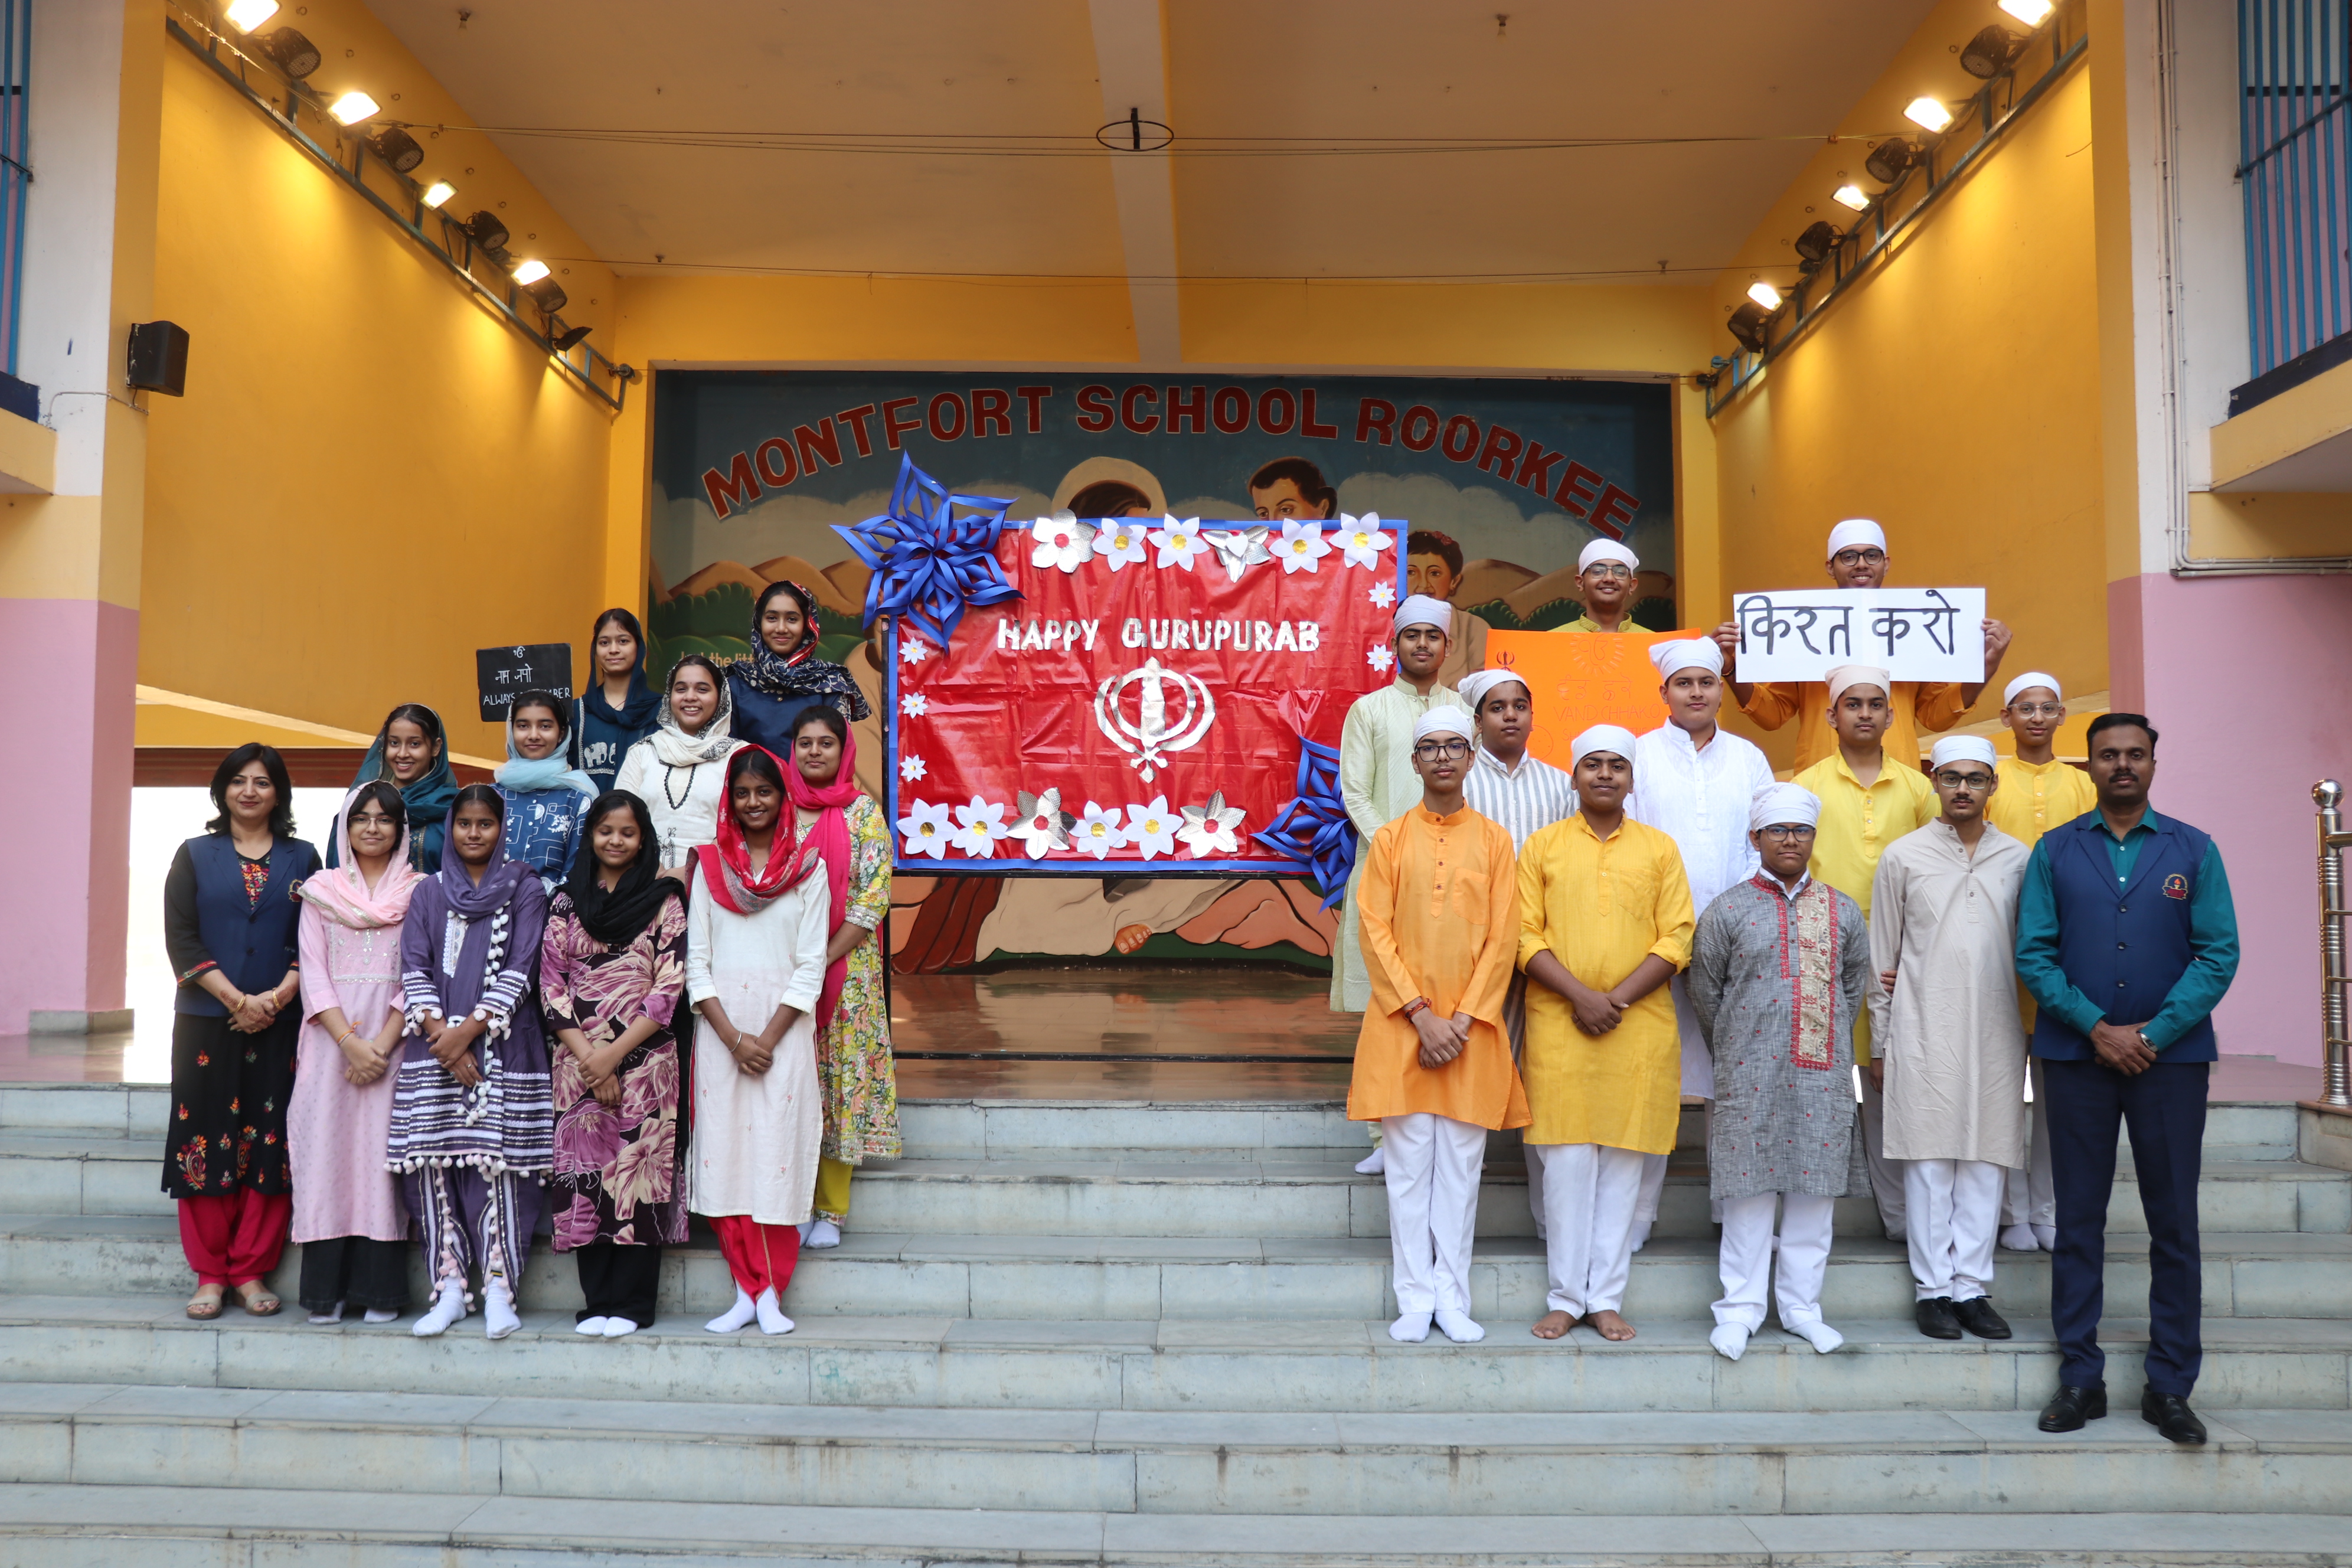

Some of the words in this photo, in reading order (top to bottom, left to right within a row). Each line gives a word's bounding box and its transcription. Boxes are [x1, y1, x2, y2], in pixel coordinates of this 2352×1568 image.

[701, 386, 1053, 521] MONTFORT
[1076, 384, 1338, 440] SCHOOL
[1355, 397, 1641, 542] ROORKEE
[1736, 594, 1854, 656] किरत
[1868, 589, 1961, 656] करो
[997, 619, 1099, 651] HAPPY
[1121, 618, 1320, 652] GURUPURAB
[709, 652, 732, 667] the
[495, 669, 511, 684] नाम
[514, 663, 534, 683] जपो
[483, 692, 516, 705] ALWAYS
[1553, 705, 1598, 722] VAND
[1600, 703, 1661, 721] CHHAKO
